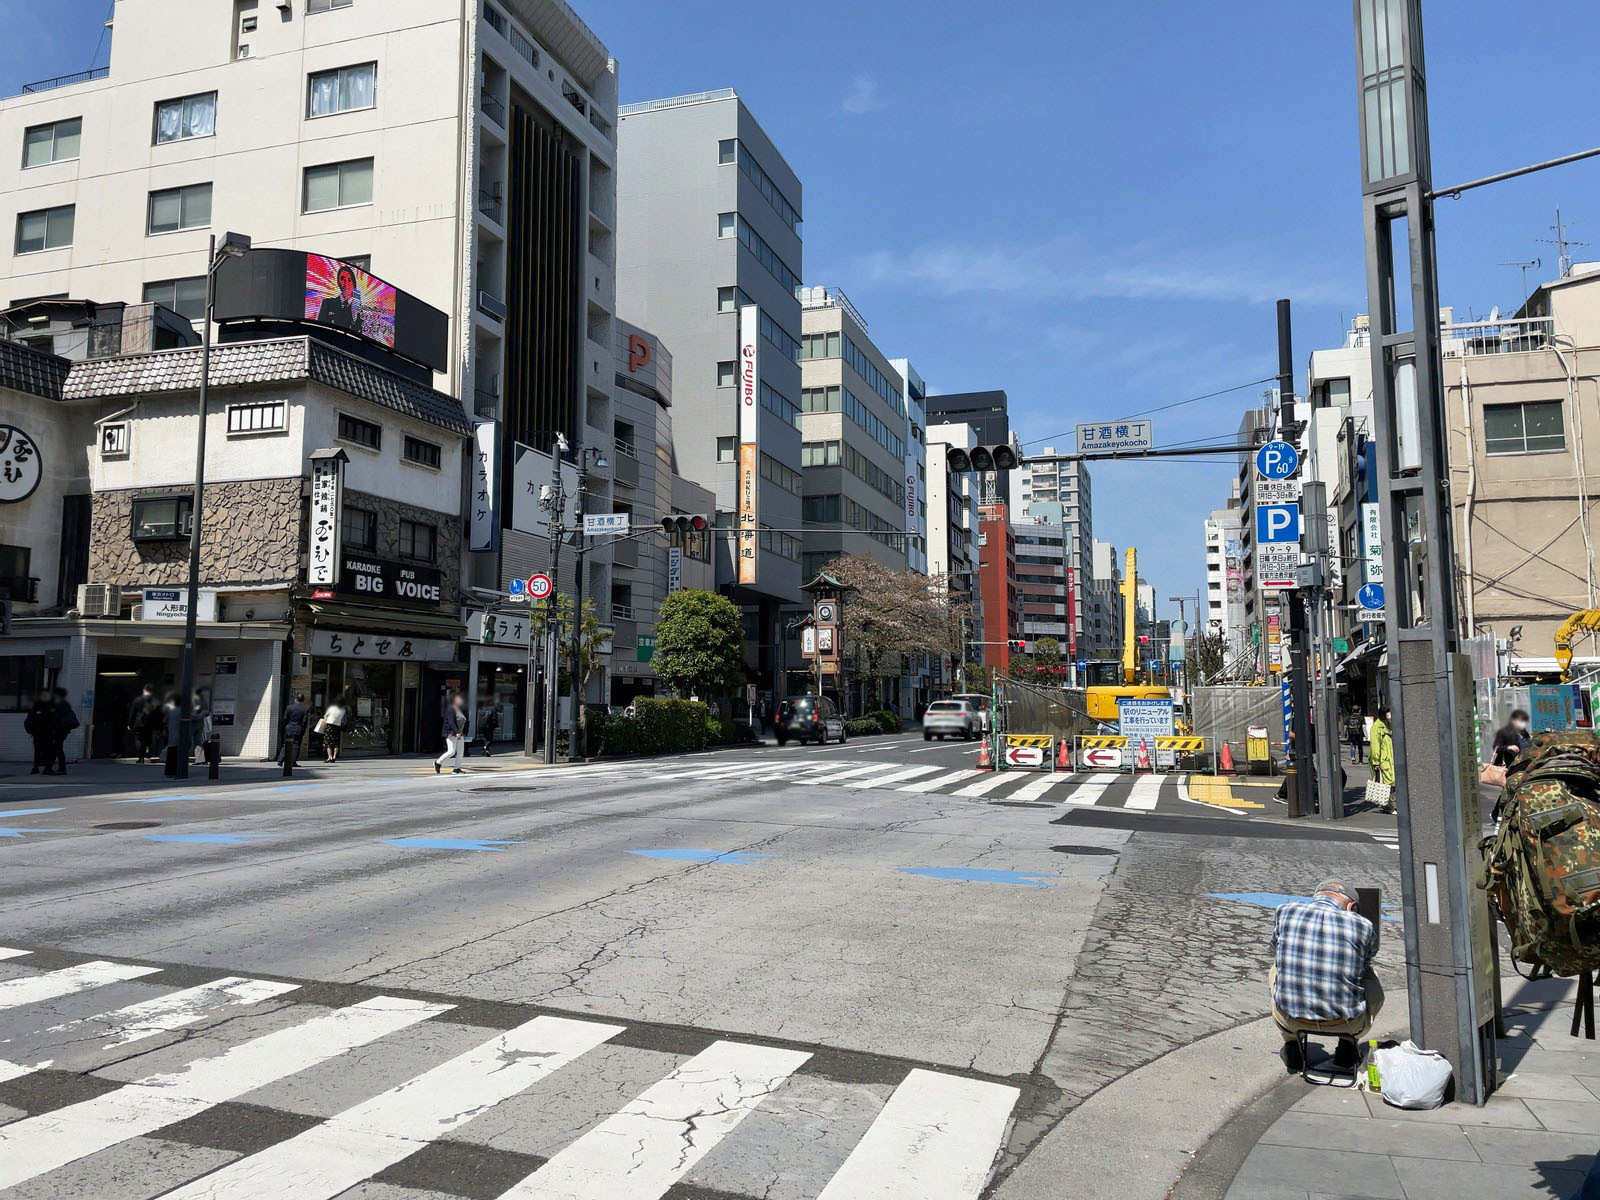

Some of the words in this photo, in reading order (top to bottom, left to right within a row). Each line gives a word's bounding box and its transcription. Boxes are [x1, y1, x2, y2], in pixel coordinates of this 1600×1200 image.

[628, 334, 651, 373] P
[742, 360, 753, 406] FUJIBO
[1081, 439, 1148, 450] Amazakeyokocho
[1082, 424, 1145, 440] 甘酒横丁
[1266, 450, 1282, 474] P
[477, 452, 487, 521] カラオケ
[587, 516, 624, 526] 甘酒横丁
[1268, 509, 1292, 540] P
[1370, 509, 1378, 538] 有限会社
[741, 514, 755, 558] 北海道
[346, 561, 381, 574] KARAOKE
[400, 570, 415, 579] PUB
[1369, 545, 1383, 576] 菊弥
[355, 575, 384, 593] BIG
[395, 581, 440, 600] VOICE
[533, 581, 547, 592] 50
[162, 604, 187, 612] 人形町
